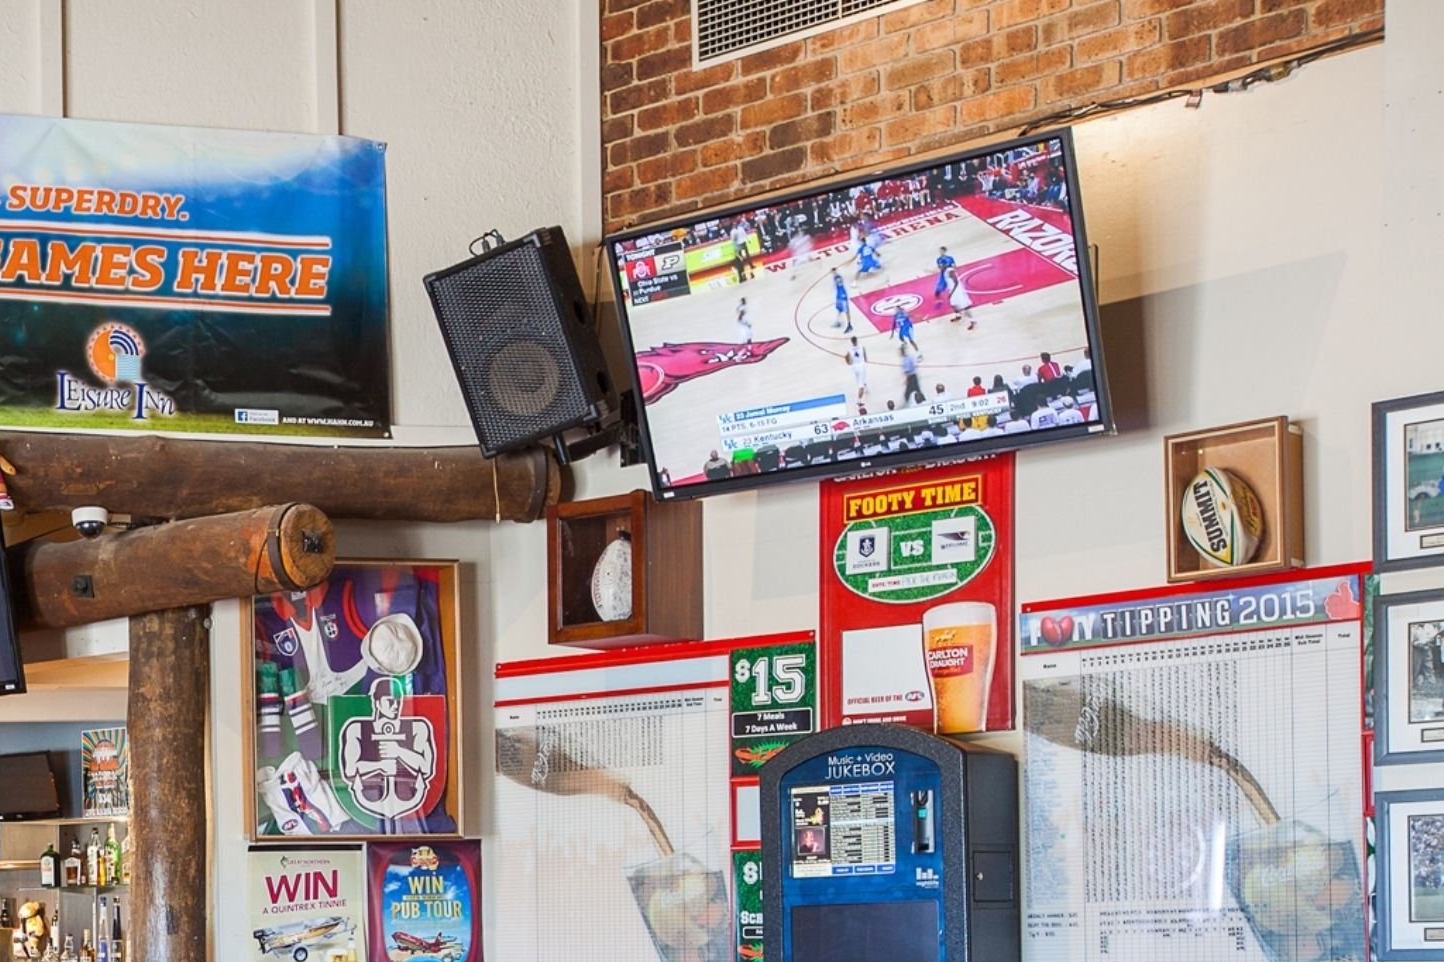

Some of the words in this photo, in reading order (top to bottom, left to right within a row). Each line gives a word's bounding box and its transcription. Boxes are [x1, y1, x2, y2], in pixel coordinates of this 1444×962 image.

[8, 184, 189, 220] SUPERDRY.
[174, 248, 331, 298] HERE
[852, 413, 895, 427] Arkansas
[928, 405, 945, 416] 45
[814, 423, 829, 435] 63
[848, 490, 916, 518] FOOTY
[921, 481, 977, 507] TIME
[1192, 480, 1228, 553] SUMMIT
[900, 539, 925, 558] VS
[1102, 598, 1231, 640] TIPPING
[1239, 590, 1315, 625] 2015
[927, 647, 968, 660] CARLTON
[734, 653, 806, 706] $15
[756, 713, 762, 721] 7
[763, 712, 785, 721] Meals
[751, 724, 768, 734] Days
[775, 722, 797, 731] Week
[828, 756, 854, 765] Music
[864, 752, 894, 762] Video
[824, 761, 895, 780] JUKEBOX
[264, 869, 338, 905] WIN
[407, 875, 444, 895] WIN
[262, 907, 269, 915] A
[271, 902, 316, 914] QUINTREX
[318, 899, 348, 909] TINNIE
[391, 902, 421, 919] PUB
[424, 900, 463, 919] TOUR
